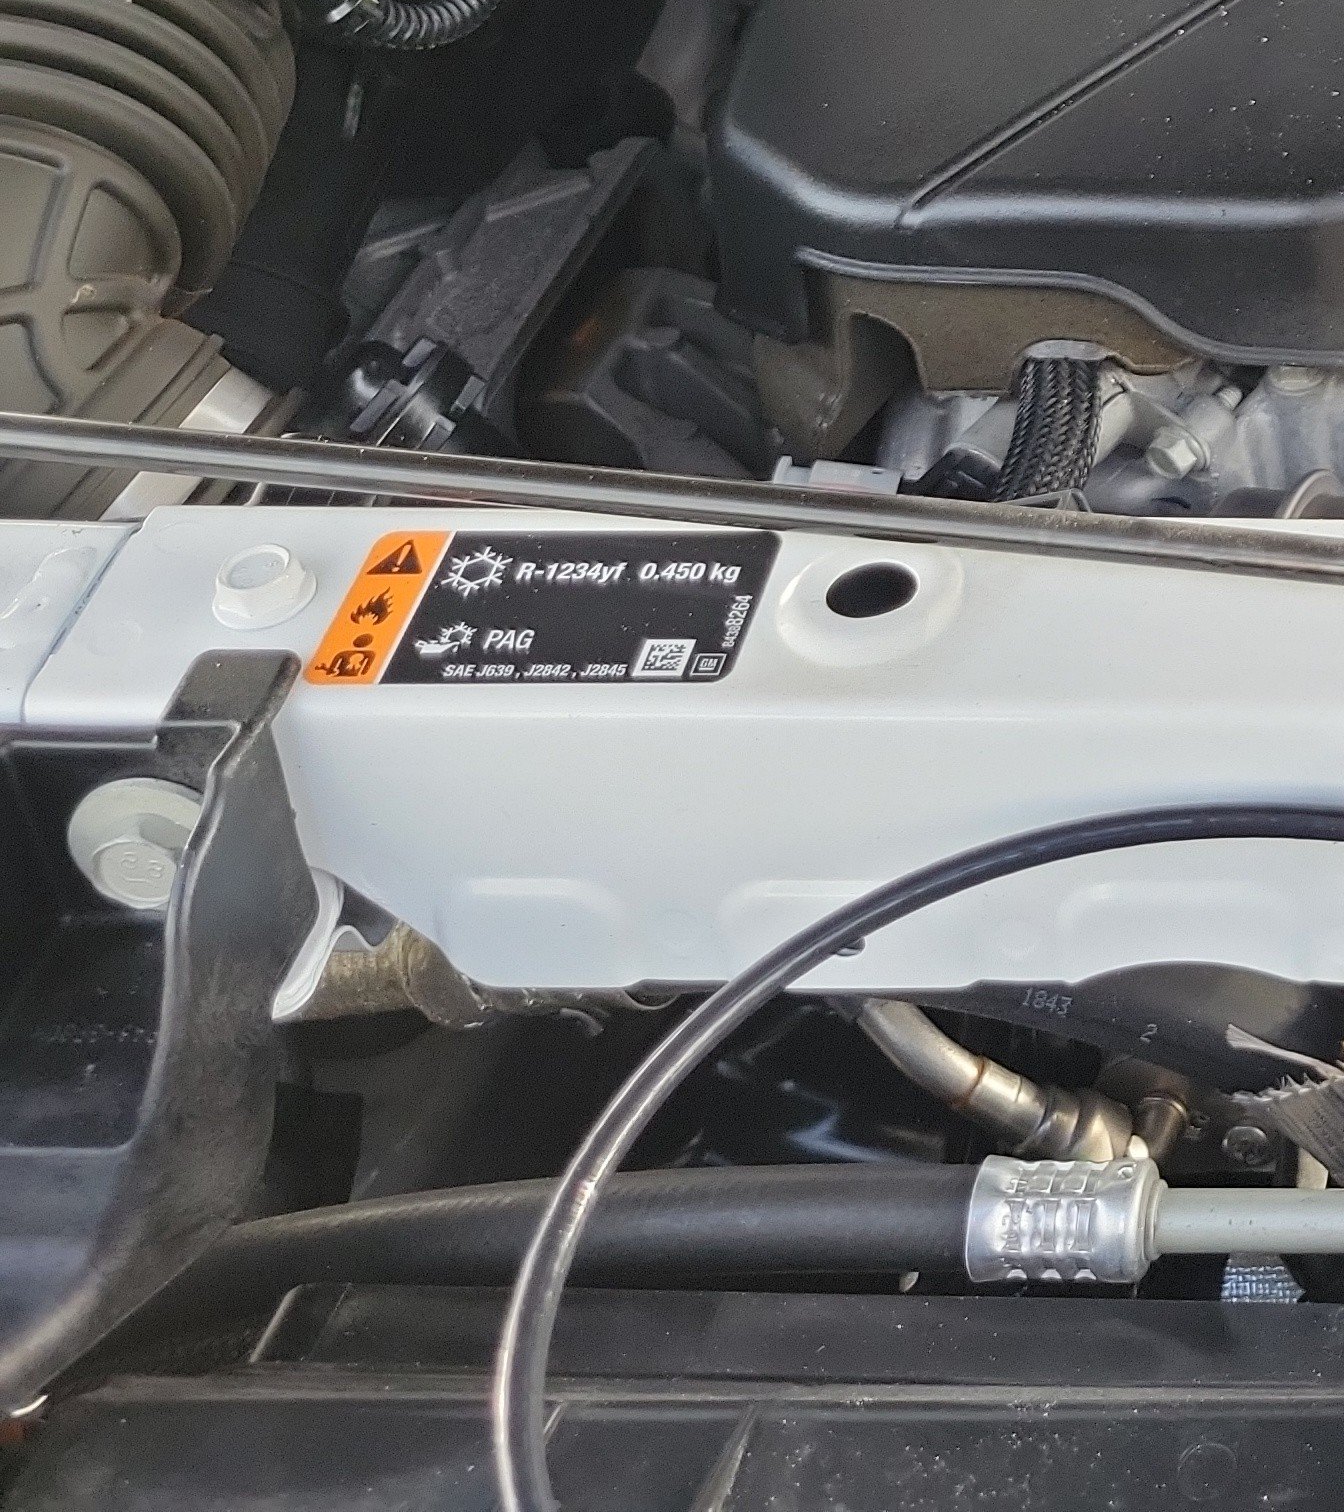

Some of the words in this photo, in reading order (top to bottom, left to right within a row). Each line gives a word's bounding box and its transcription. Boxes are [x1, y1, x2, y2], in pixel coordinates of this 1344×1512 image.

[515, 562, 627, 584] R-1234yf
[641, 562, 706, 581] 0.450
[709, 562, 742, 584] kg
[483, 629, 536, 649] PAG
[443, 664, 475, 678] SAE
[580, 664, 628, 678] J2845
[698, 658, 720, 670] GM
